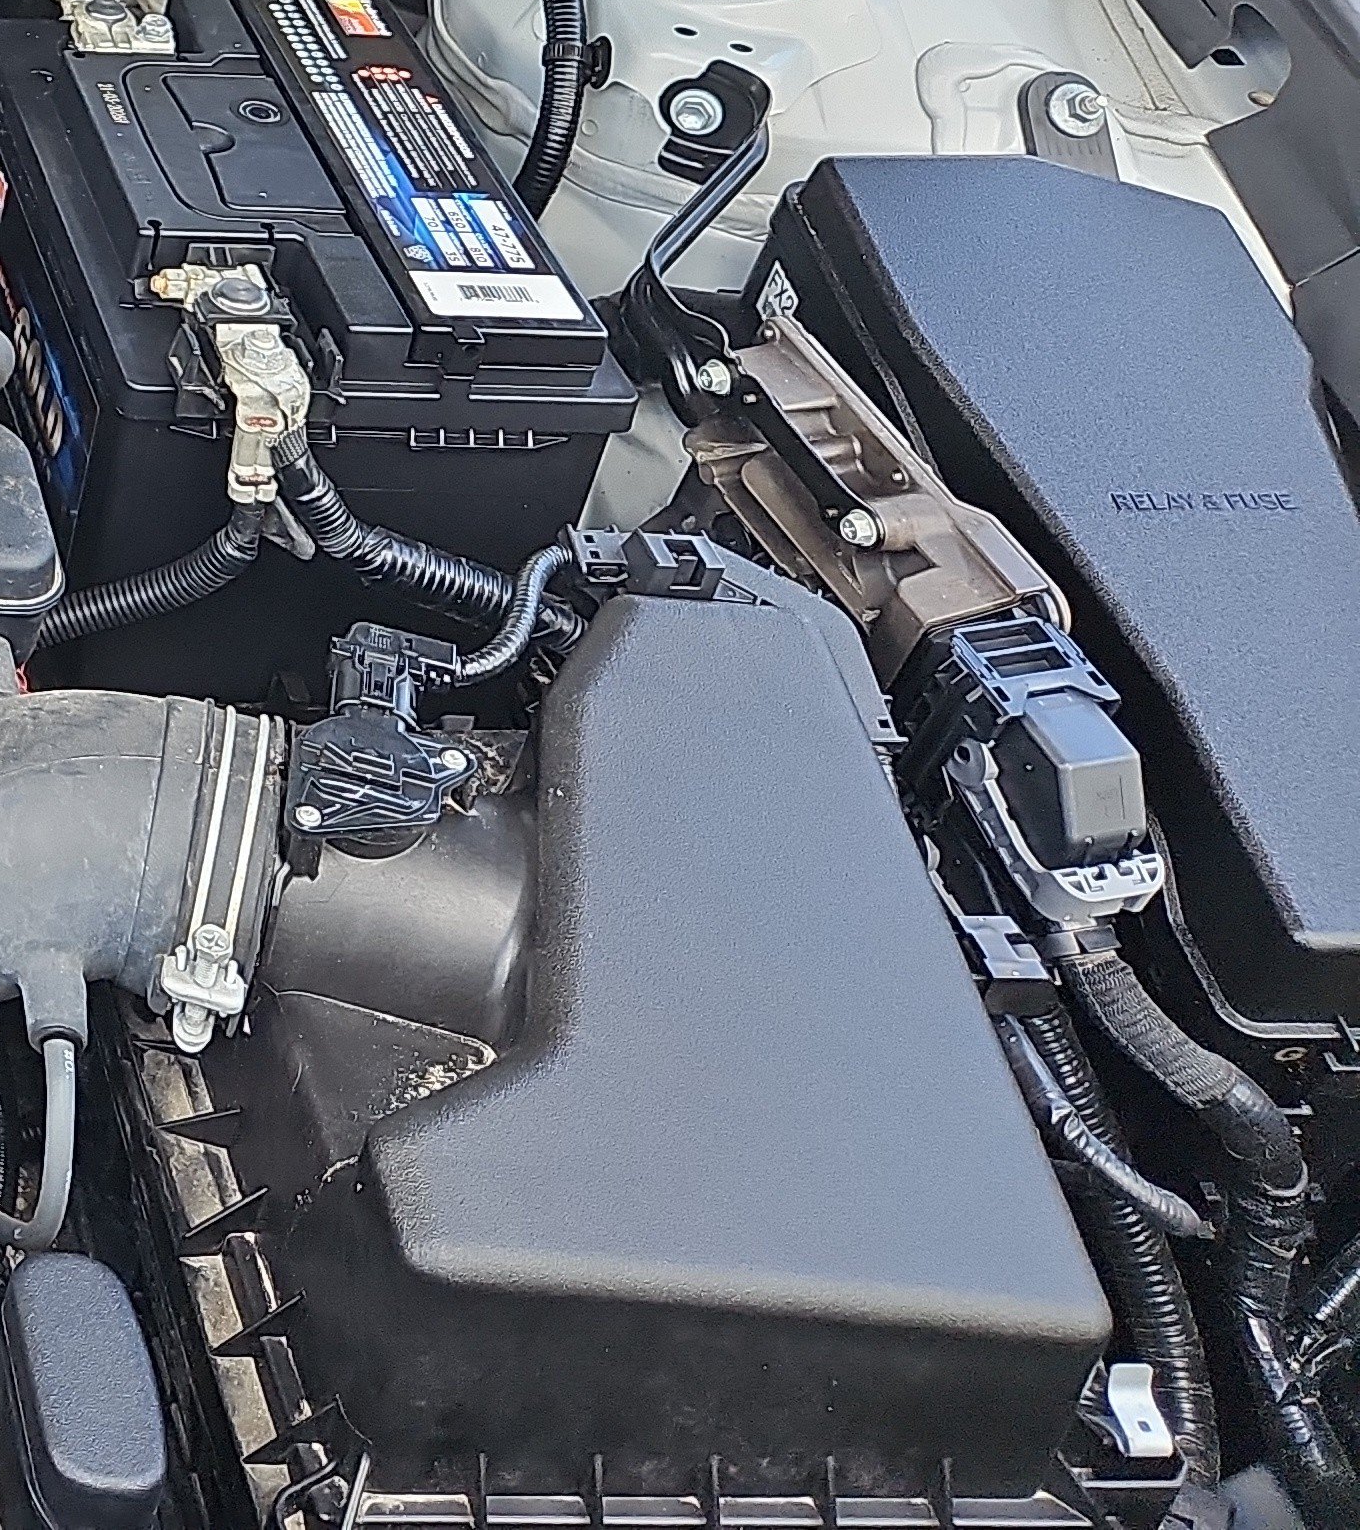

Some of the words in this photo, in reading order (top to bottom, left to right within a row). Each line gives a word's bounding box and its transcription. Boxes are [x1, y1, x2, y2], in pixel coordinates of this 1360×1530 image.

[424, 216, 439, 228] 70
[448, 210, 467, 230] 650
[492, 223, 526, 265] 47-775
[445, 250, 461, 263] 35
[469, 246, 488, 264] 810
[1109, 492, 1194, 513] RELAY
[1201, 493, 1222, 511] &
[1222, 492, 1299, 512] FUSE
